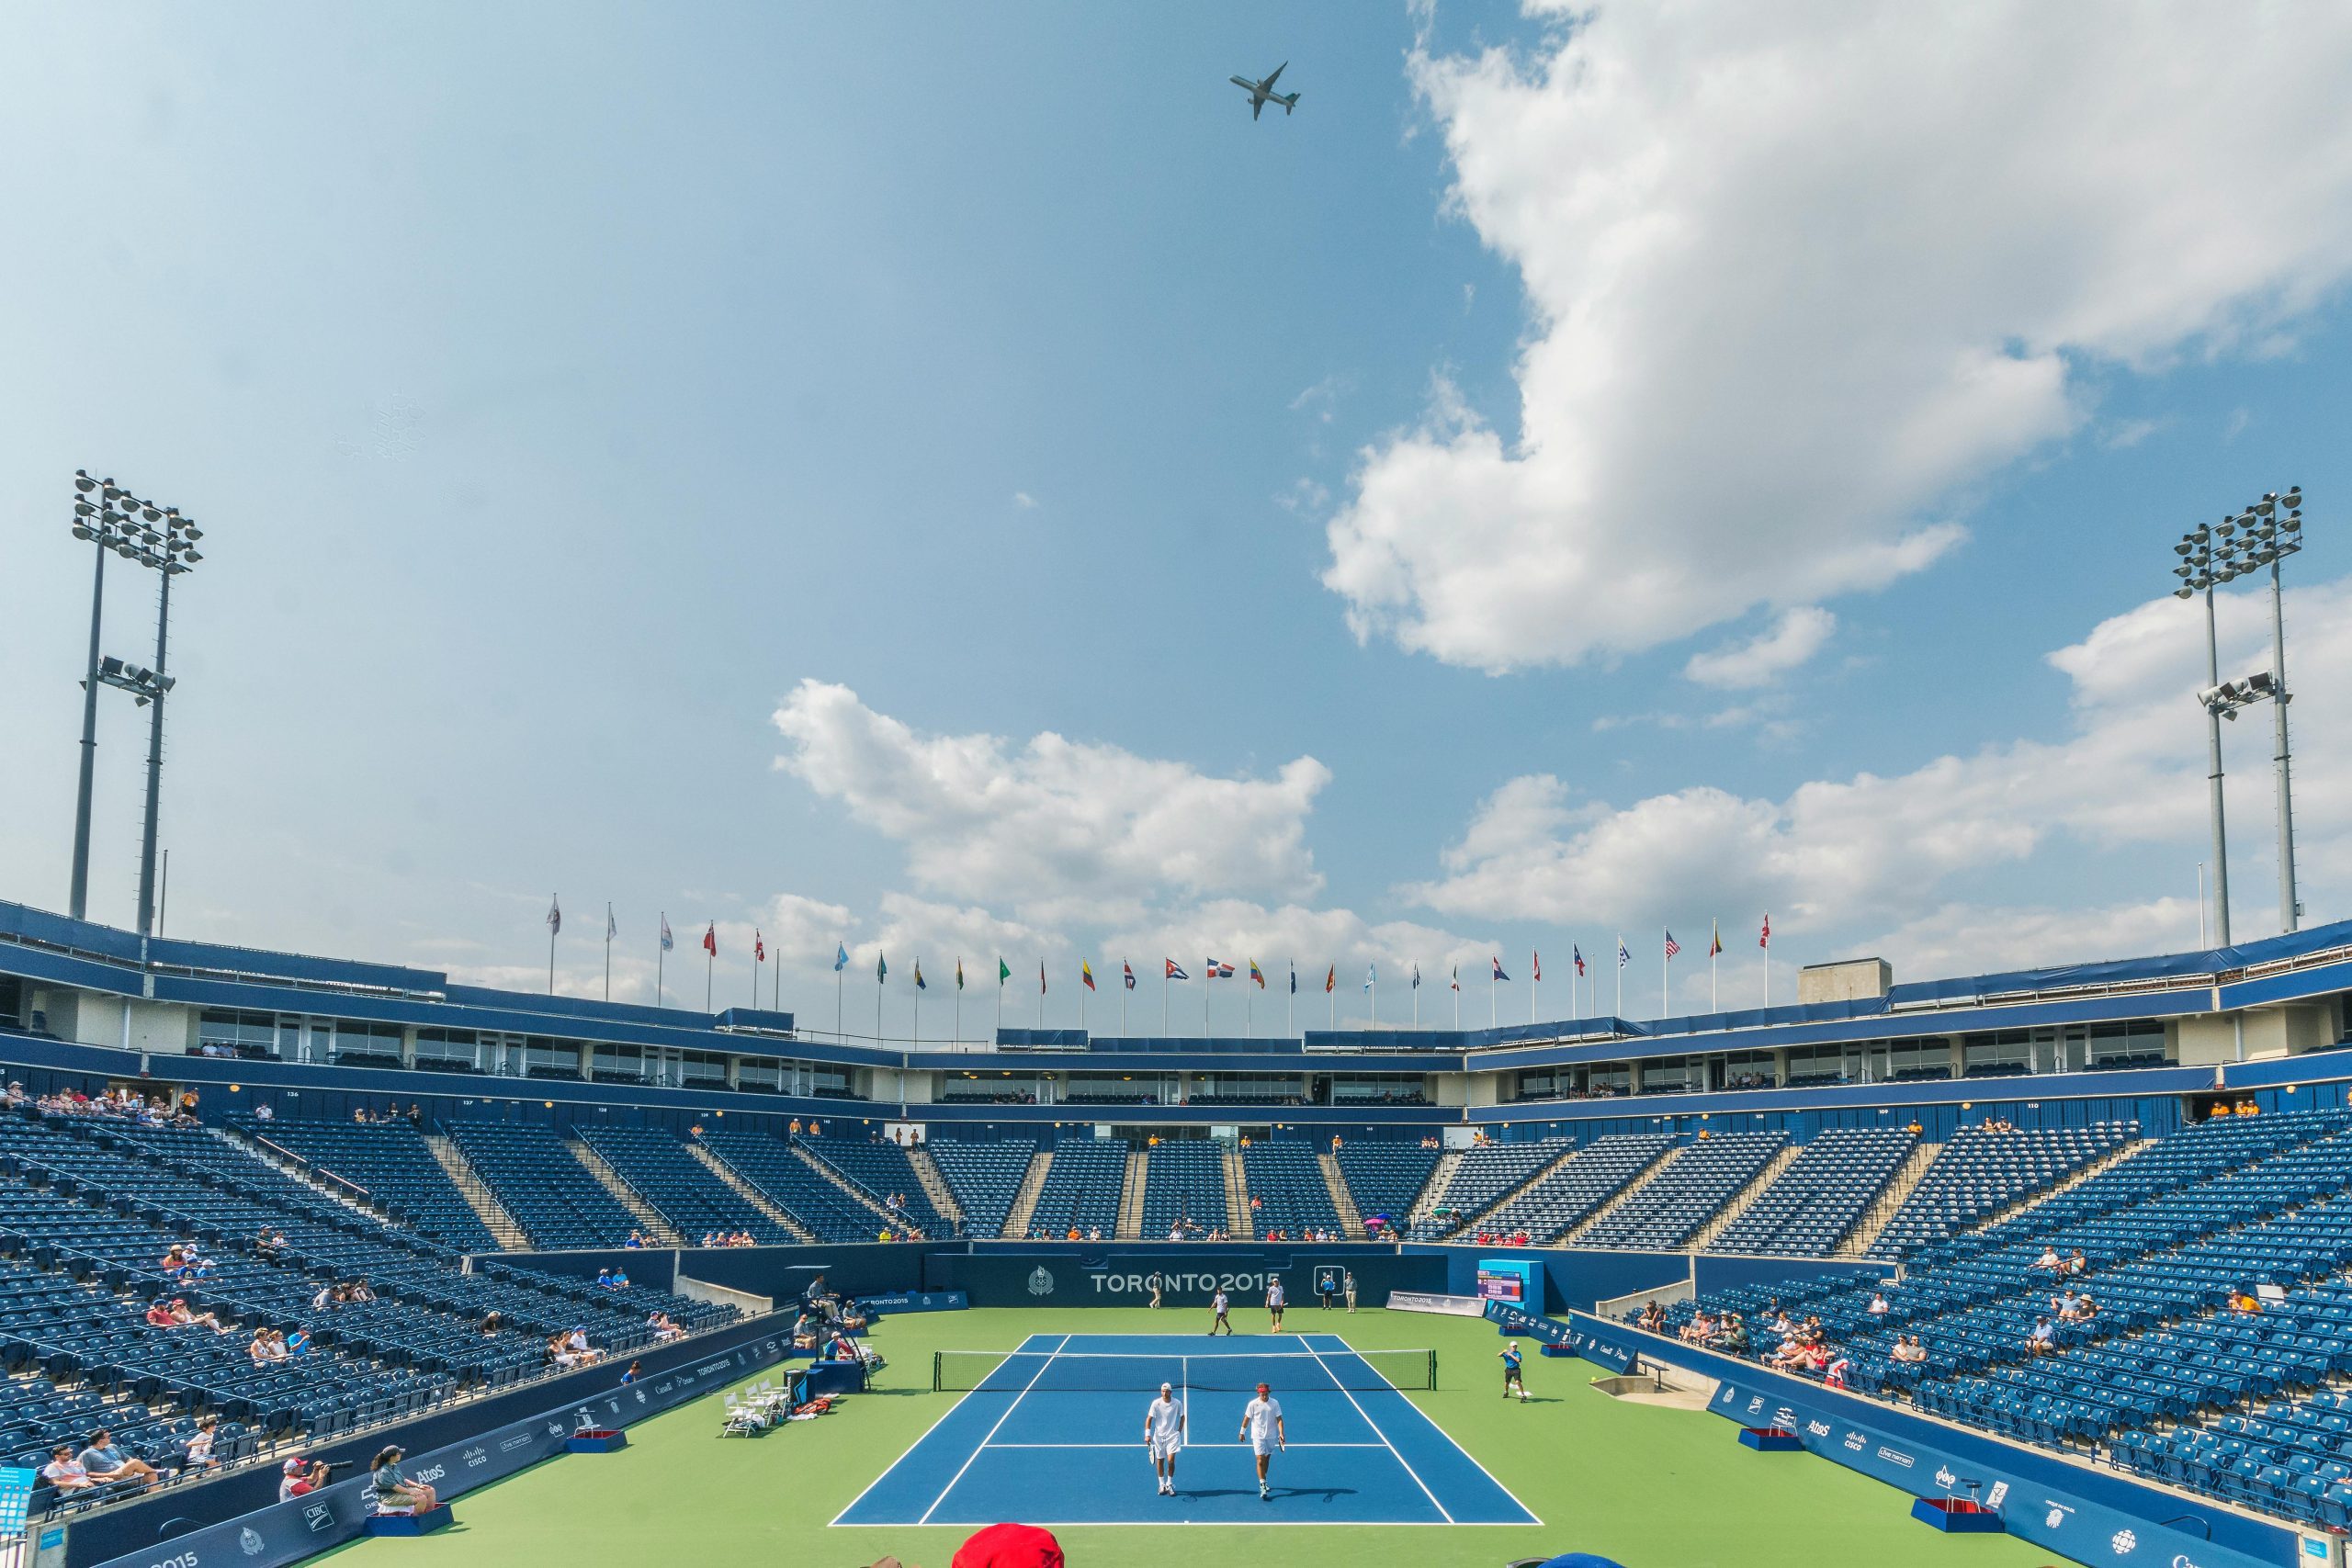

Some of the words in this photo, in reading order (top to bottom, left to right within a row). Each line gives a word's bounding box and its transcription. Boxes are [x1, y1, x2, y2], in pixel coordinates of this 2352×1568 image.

[1806, 1420, 1830, 1437] Atos
[415, 1463, 446, 1484] Atos
[306, 1504, 327, 1518] CIBC
